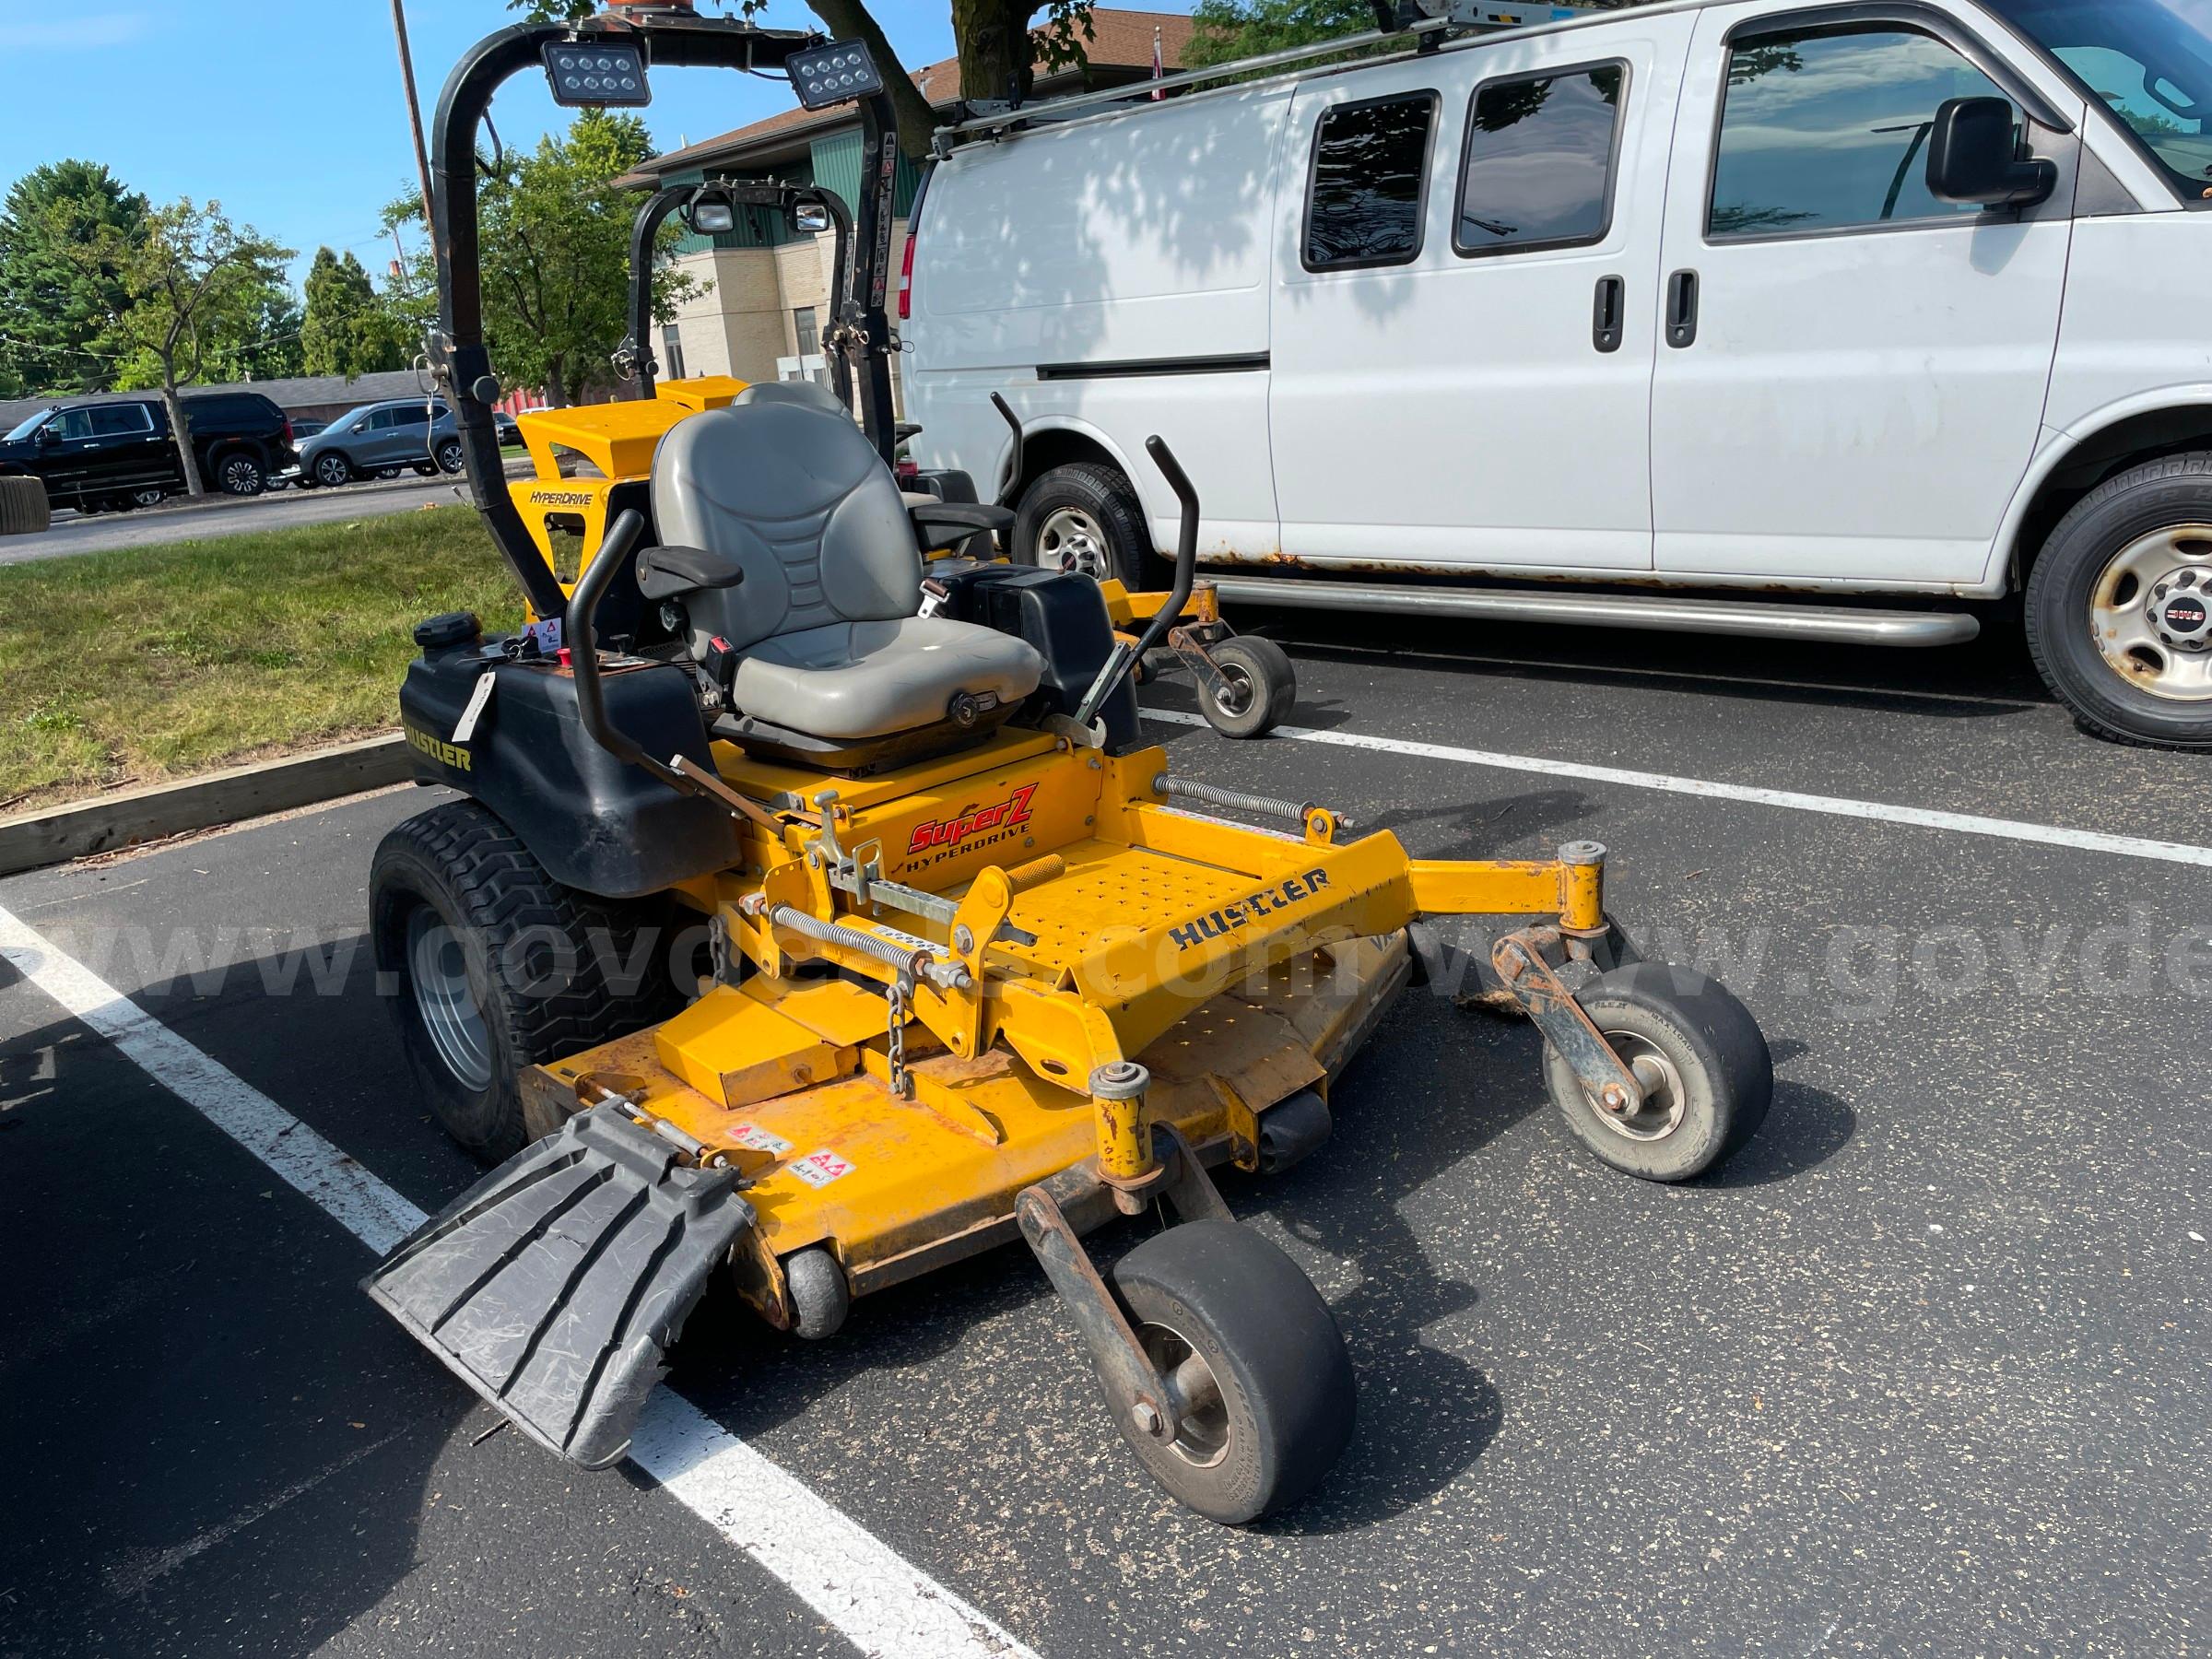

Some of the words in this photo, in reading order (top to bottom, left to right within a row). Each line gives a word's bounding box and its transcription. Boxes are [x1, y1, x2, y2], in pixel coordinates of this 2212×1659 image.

[529, 491, 594, 505] HYPERDRIVE
[404, 724, 471, 771] HUSTLER
[907, 823, 1030, 873] HYPERDRIVE
[1168, 868, 1328, 951] HUSTLER
